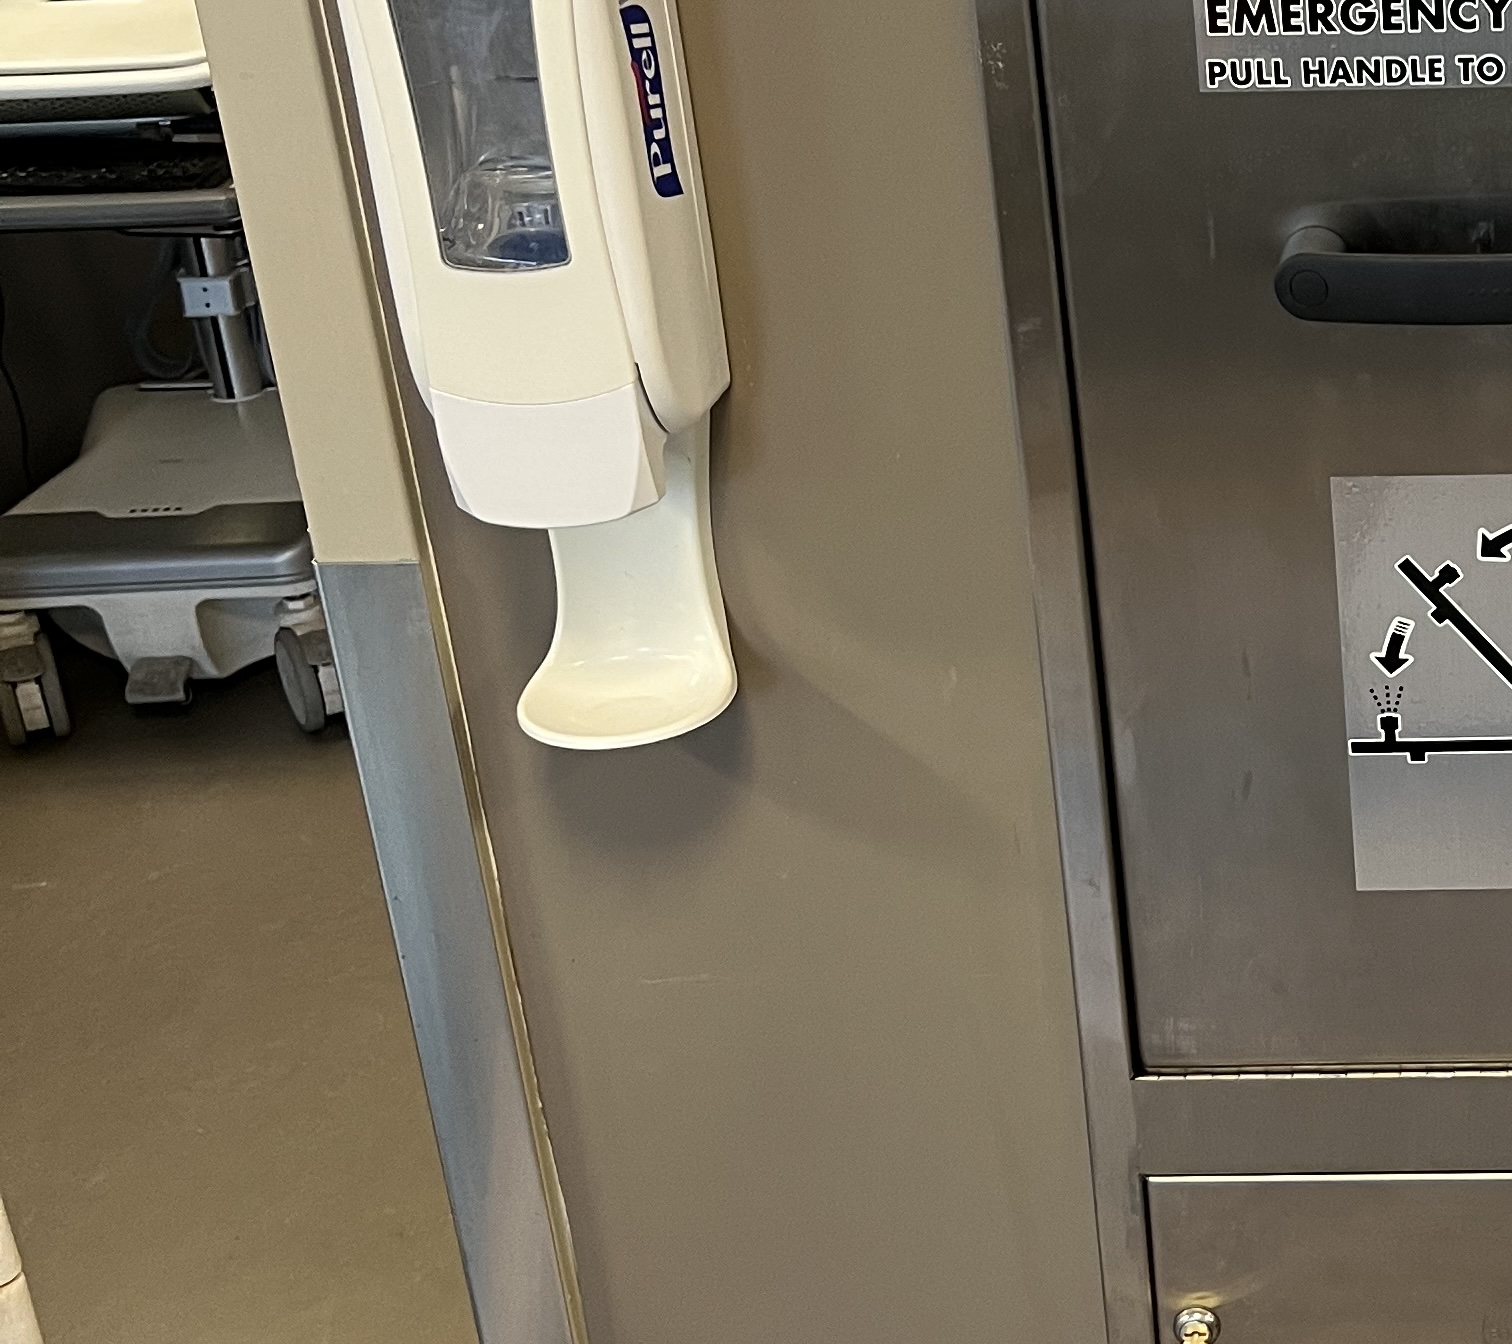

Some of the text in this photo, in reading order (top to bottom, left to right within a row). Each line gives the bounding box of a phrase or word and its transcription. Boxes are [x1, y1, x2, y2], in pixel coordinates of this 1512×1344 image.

[629, 21, 673, 185] Purell
[1206, 57, 1290, 88] PULL
[1302, 54, 1444, 87] HANDLE
[1457, 54, 1505, 84] TO
